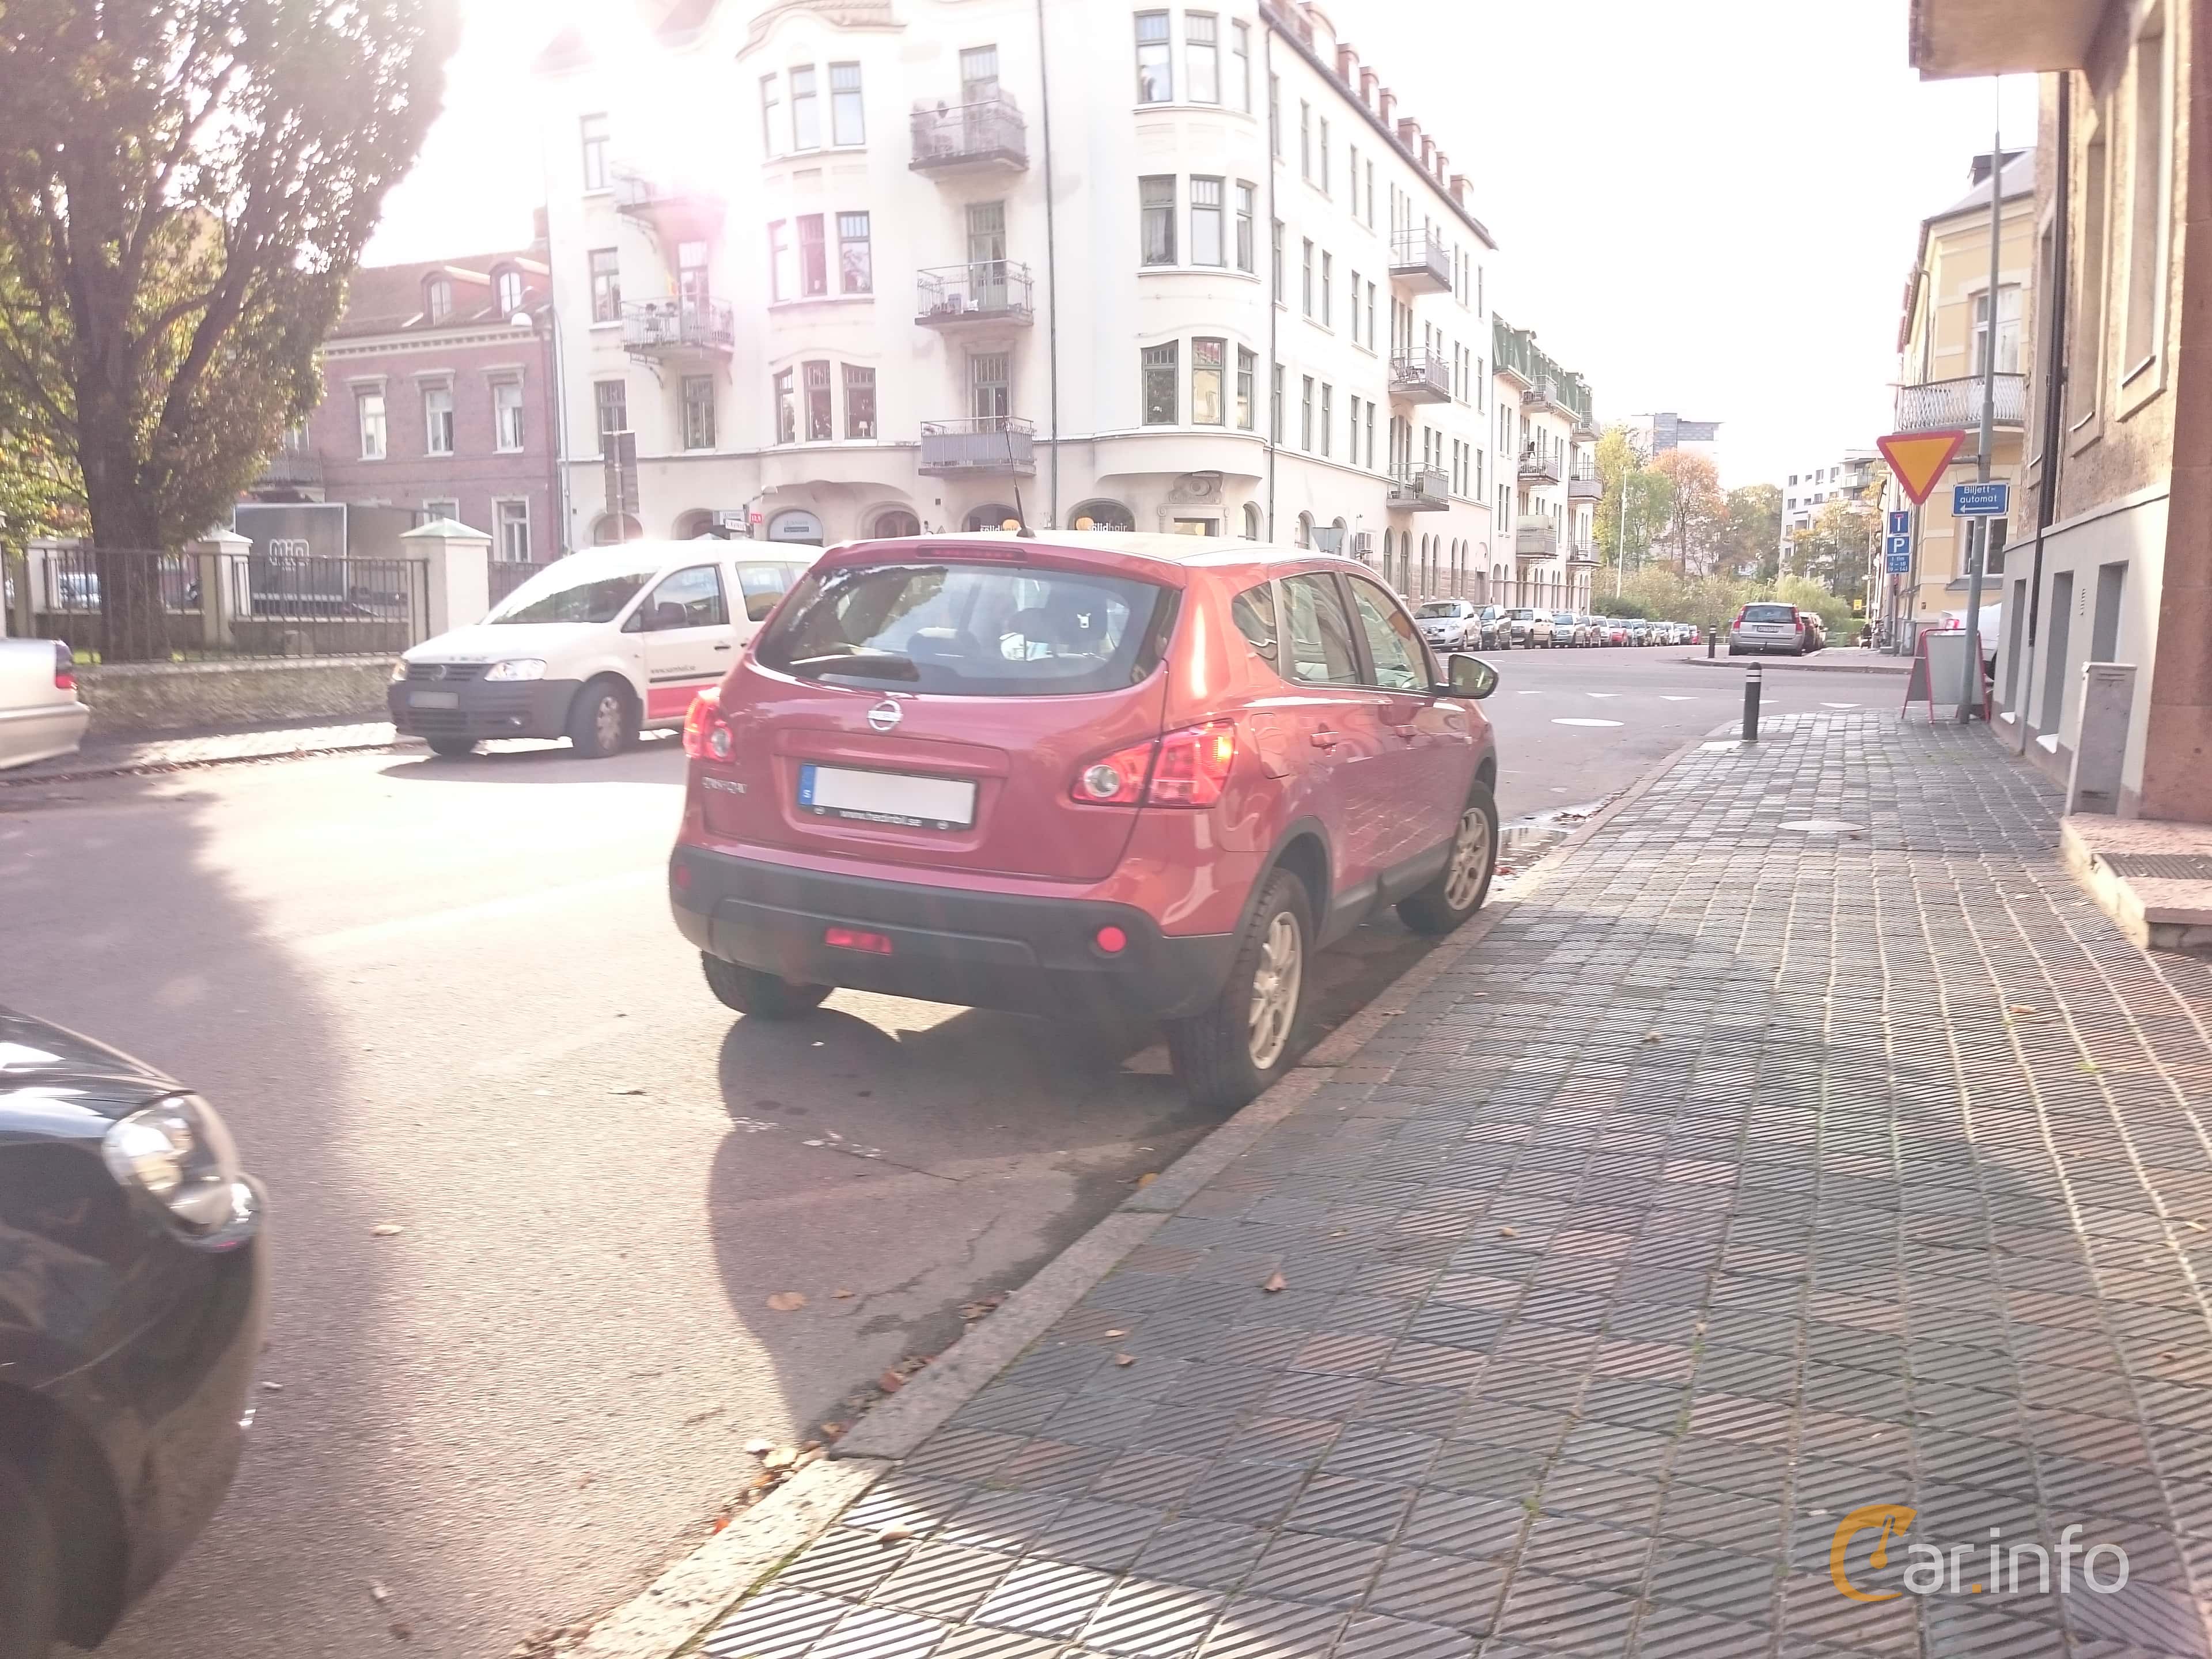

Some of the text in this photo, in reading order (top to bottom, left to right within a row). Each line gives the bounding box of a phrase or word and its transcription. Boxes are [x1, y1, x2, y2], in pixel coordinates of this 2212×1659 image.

[1964, 485, 1995, 495] Biljett-
[1960, 494, 1997, 503] automat
[1893, 537, 1905, 553] P
